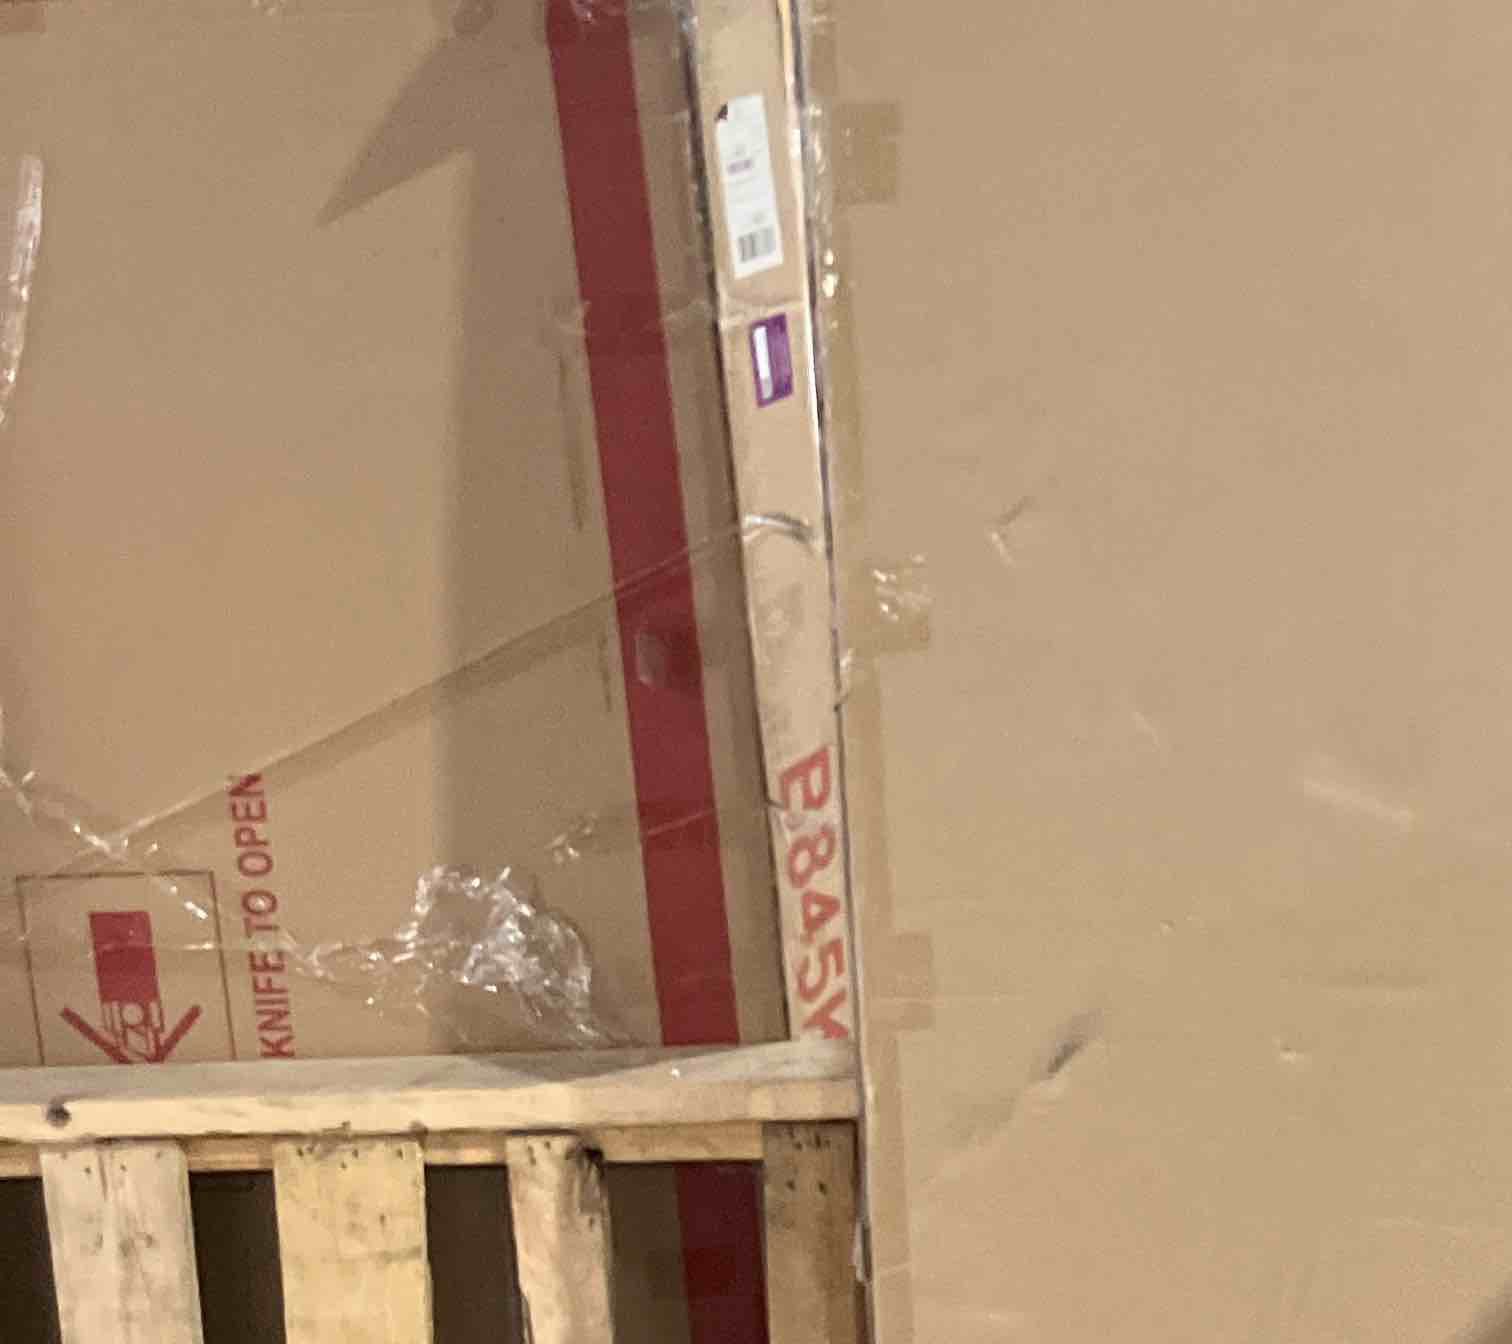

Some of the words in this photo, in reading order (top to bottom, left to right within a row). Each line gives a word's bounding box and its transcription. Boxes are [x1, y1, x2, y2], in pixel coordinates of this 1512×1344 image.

[227, 773, 274, 878] OPEN
[241, 889, 280, 937] TO
[249, 950, 295, 1059] KNIFE
